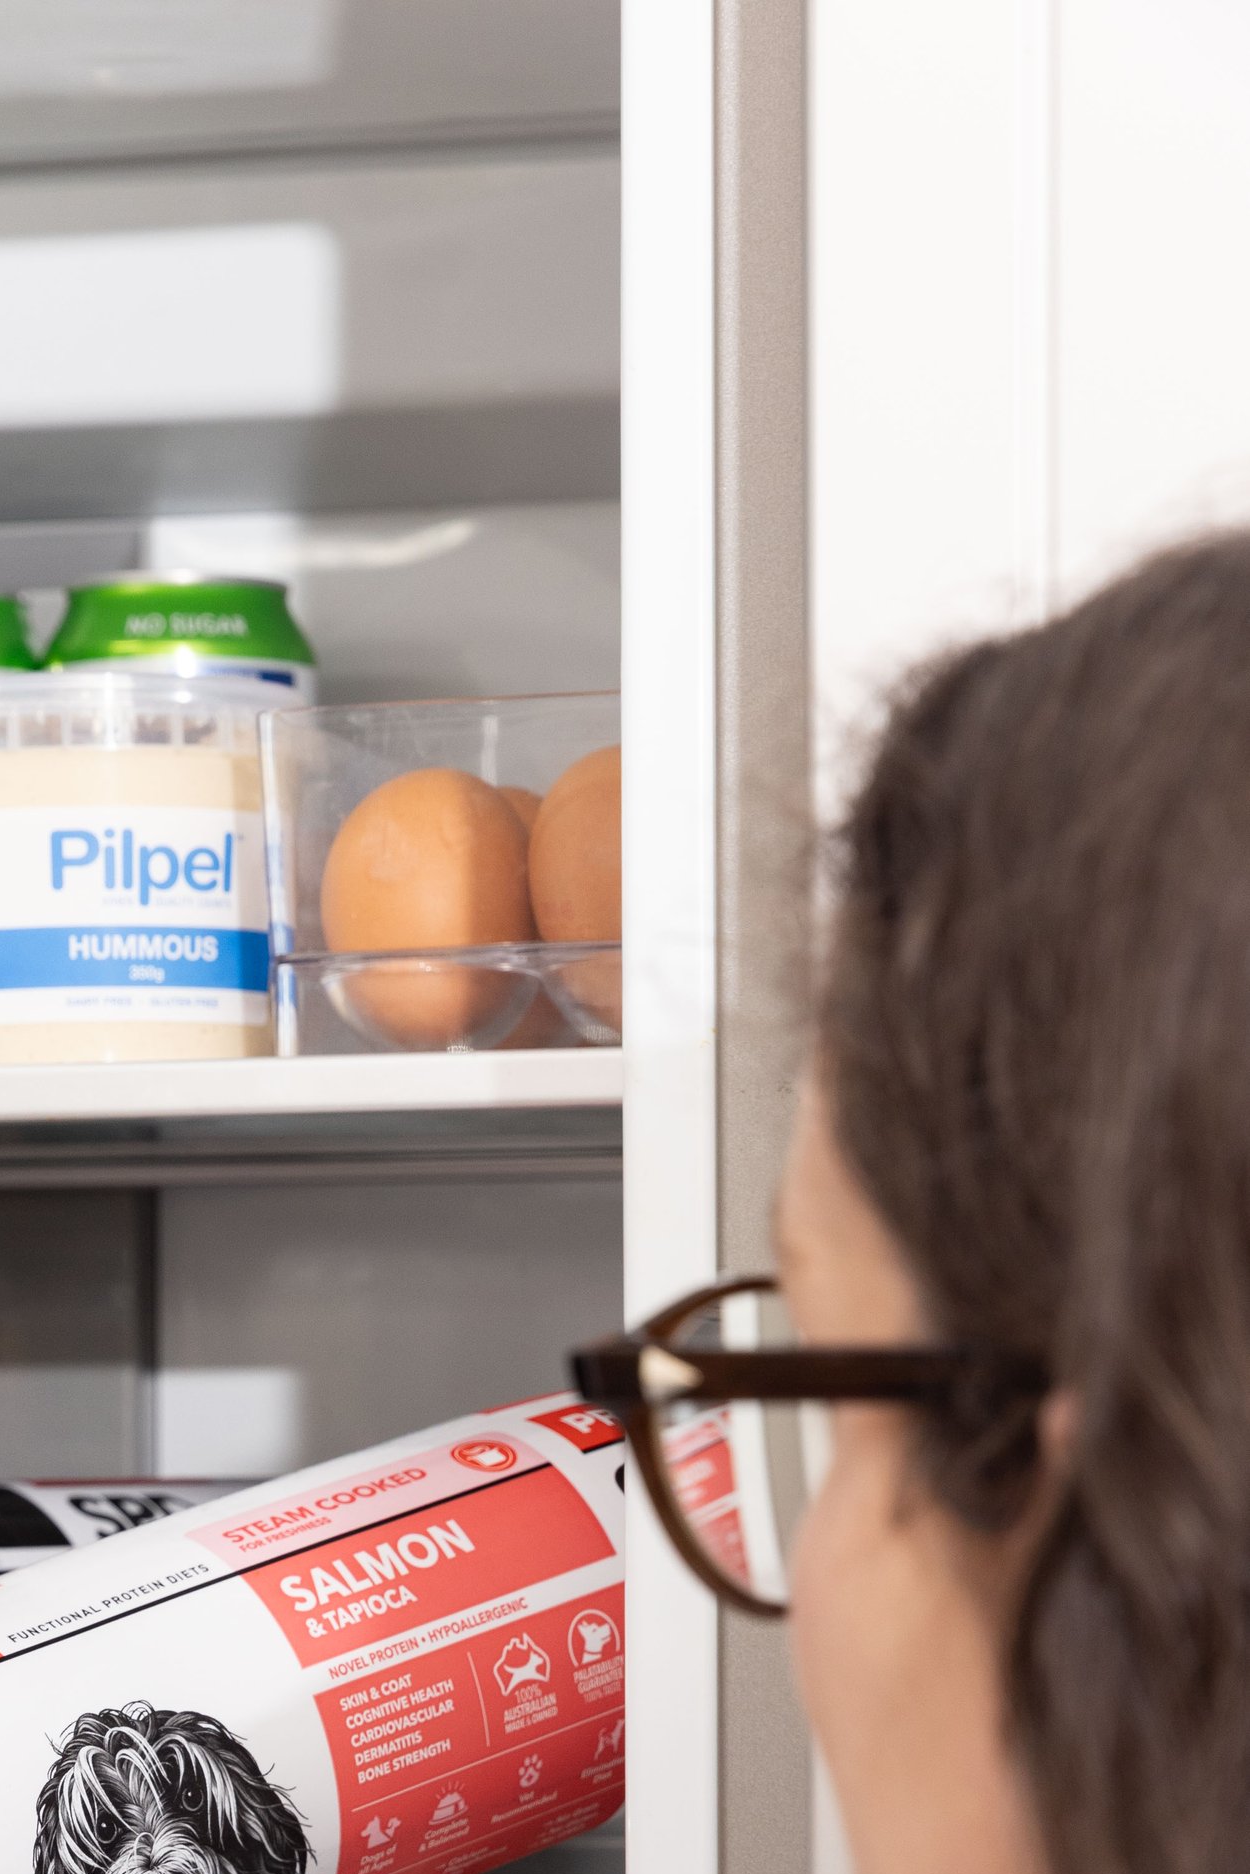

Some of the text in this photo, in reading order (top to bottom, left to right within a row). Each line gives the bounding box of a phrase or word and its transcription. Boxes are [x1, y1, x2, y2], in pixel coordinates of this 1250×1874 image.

[126, 612, 247, 637] NO SUGAR
[51, 828, 233, 906] Pilpel
[68, 934, 219, 962] HUMMOUS
[222, 1467, 428, 1545] STEAM COOKED
[238, 1516, 333, 1554] FOR FRESHNESS
[279, 1519, 475, 1612] SALMON
[8, 1563, 210, 1644] FUNCTIONAL PROTEIN DIETS
[305, 1585, 418, 1638] & TAPIOCA
[328, 1596, 529, 1680] NOVEL PROTEIN HYPOALLERGENIC
[339, 1673, 412, 1711] SKIN & COAT
[345, 1678, 454, 1729] COGNITIVE HEALTH
[504, 1693, 557, 1722] AUSTRALIAN
[514, 1684, 542, 1703] 100%
[350, 1699, 454, 1747] CARDIOVASCULAR
[354, 1730, 423, 1766] DERMATITIS
[357, 1738, 451, 1784] BONE STRENGTH
[424, 1819, 469, 1840] Complete
[427, 1825, 470, 1848] Balanced
[360, 1842, 398, 1866] Dogs of
[371, 1858, 394, 1871] Ages
